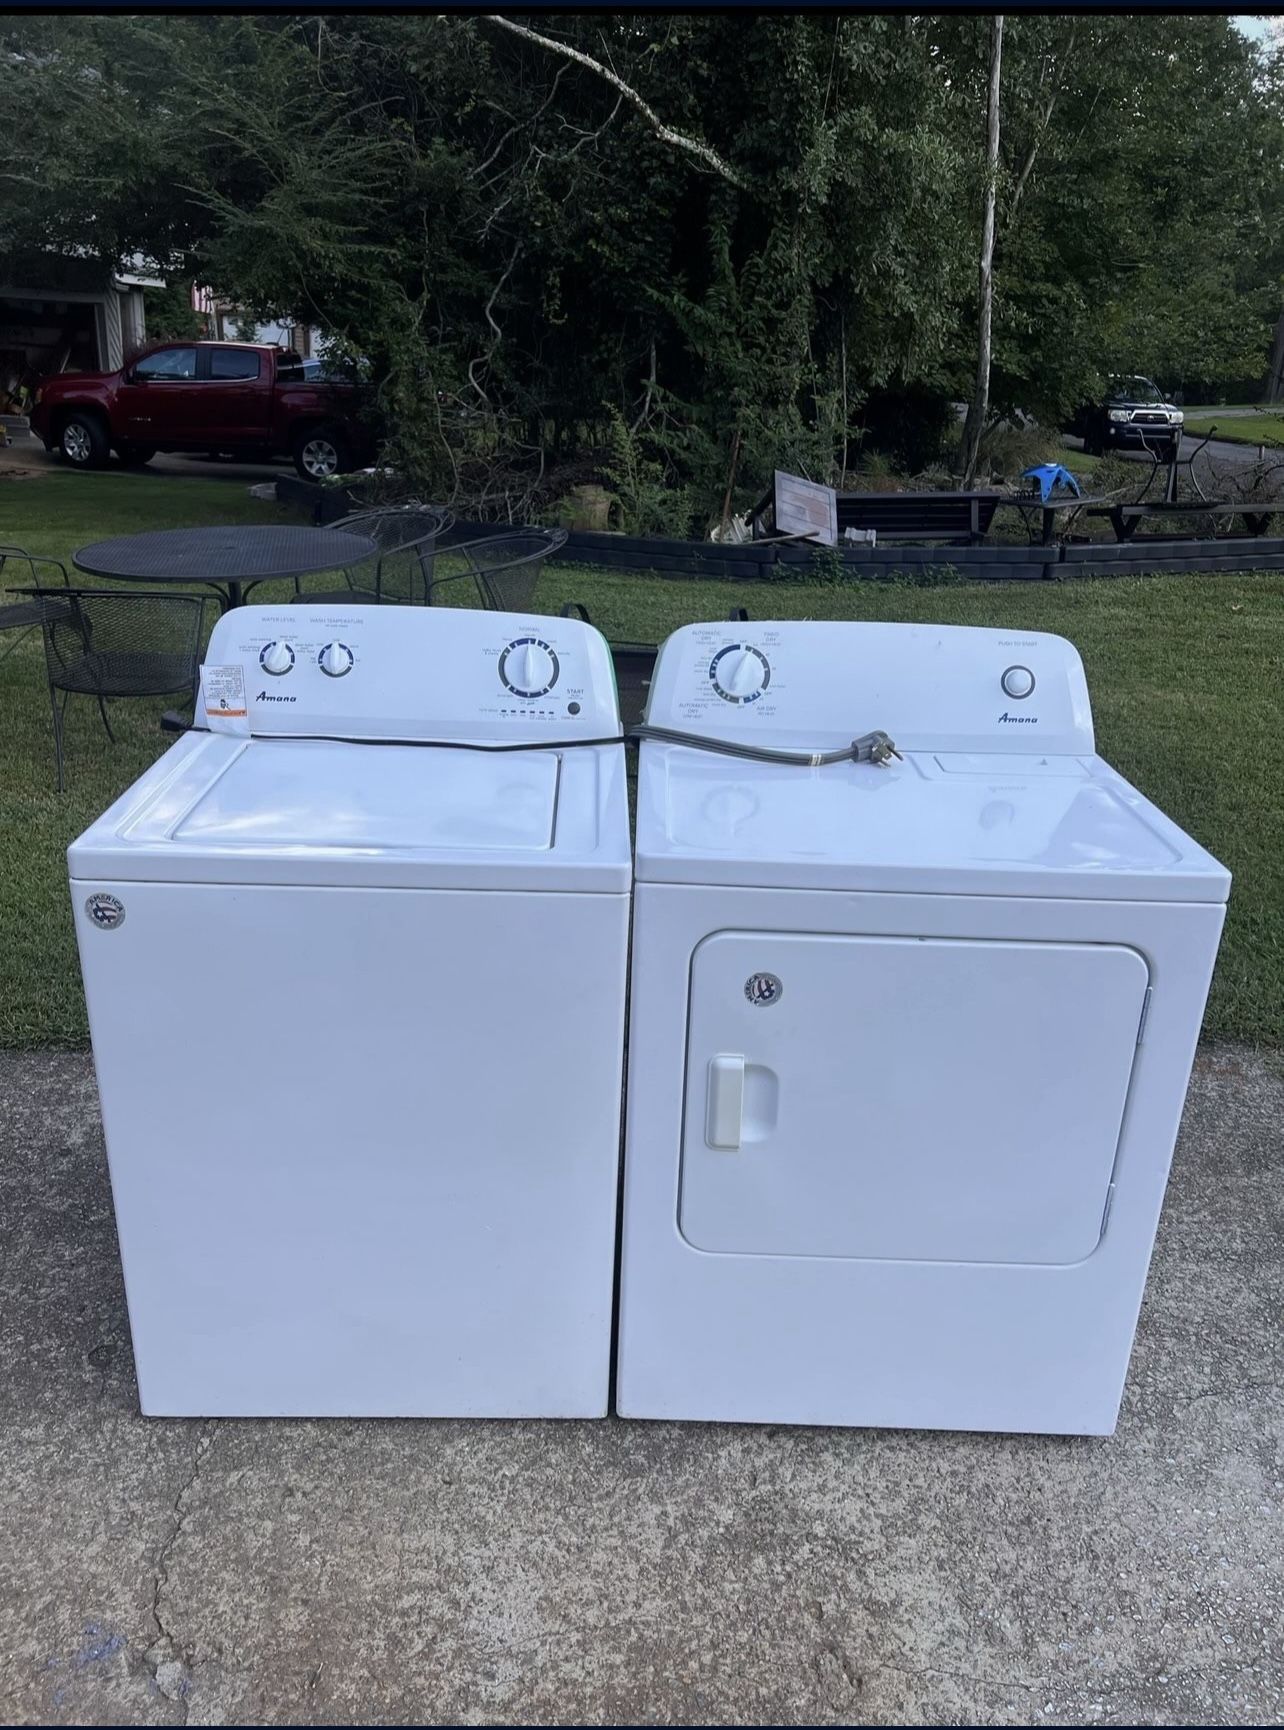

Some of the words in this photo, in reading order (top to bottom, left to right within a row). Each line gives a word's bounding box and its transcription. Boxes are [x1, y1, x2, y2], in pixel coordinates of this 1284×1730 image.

[256, 691, 297, 702] Amana
[998, 712, 1038, 723] Amana
[89, 895, 124, 912] AMERICA
